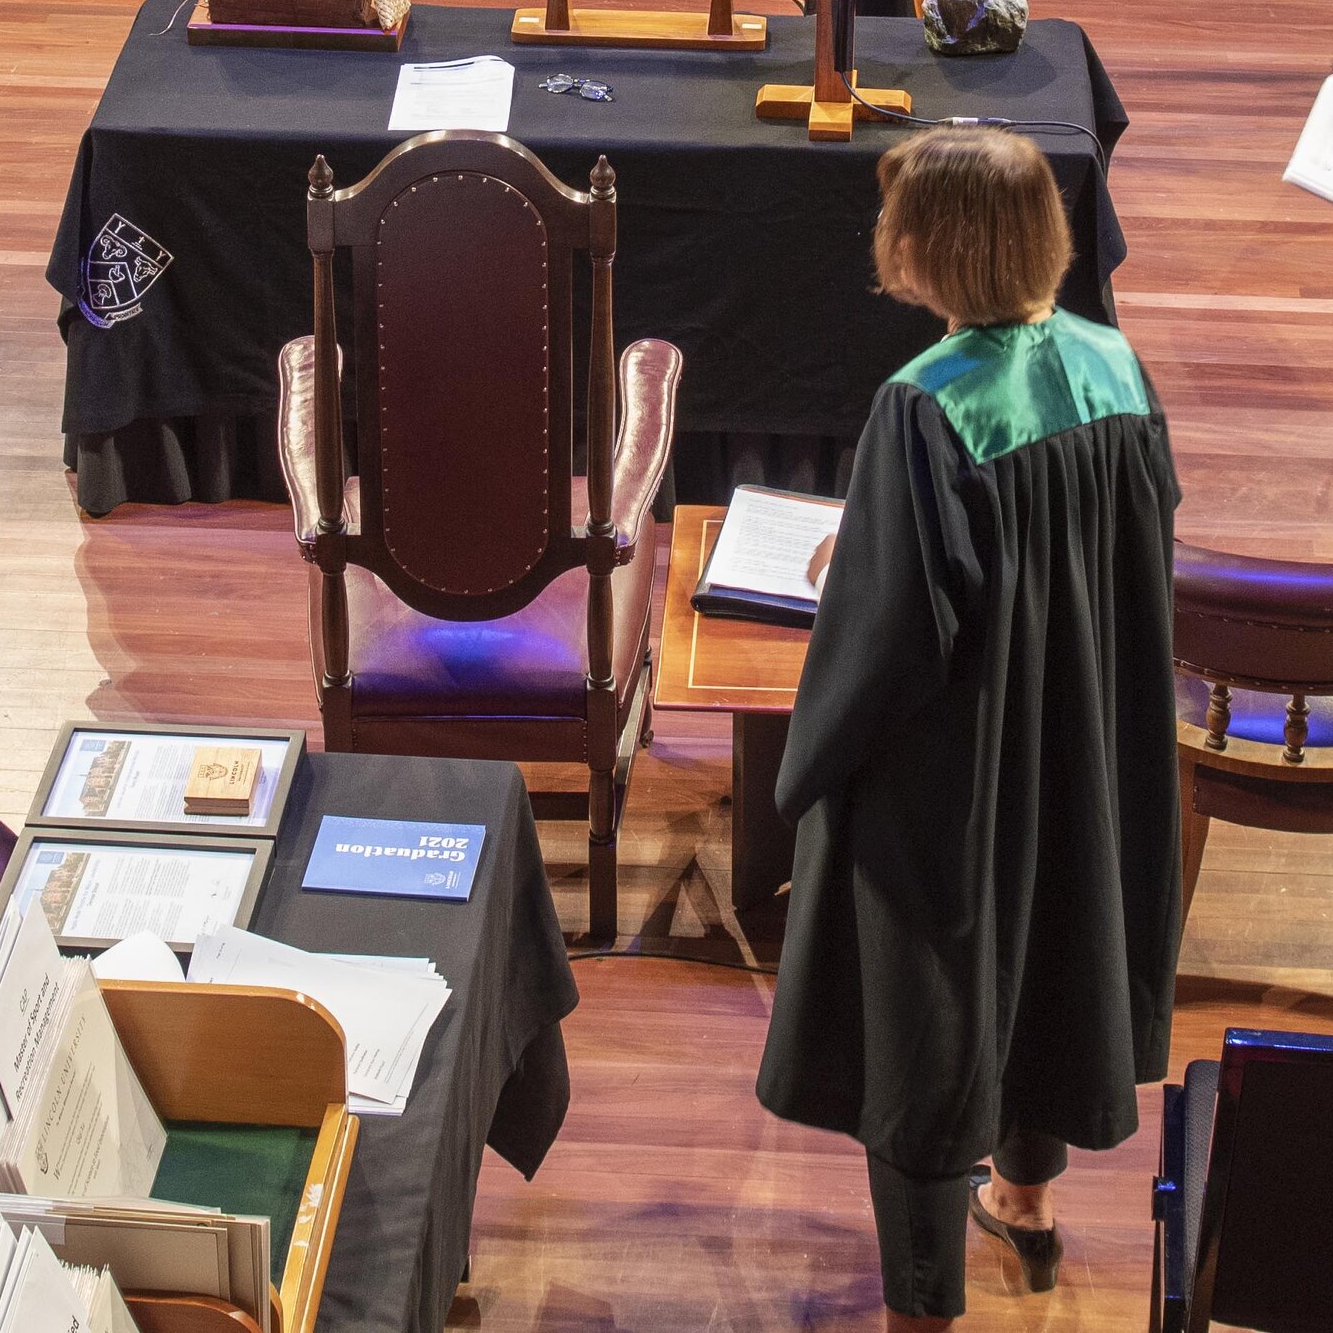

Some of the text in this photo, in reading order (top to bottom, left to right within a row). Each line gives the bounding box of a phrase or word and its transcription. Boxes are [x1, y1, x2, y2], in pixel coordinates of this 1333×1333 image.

[335, 843, 466, 861] Graduation
[419, 836, 470, 849] 2021
[13, 1033, 28, 1073] Master
[30, 994, 43, 1025] Sport
[41, 972, 49, 998] and
[15, 981, 60, 1102] Recreation Management
[41, 1086, 62, 1143] LINCOLN
[60, 1016, 85, 1085] UNIVERSITY
